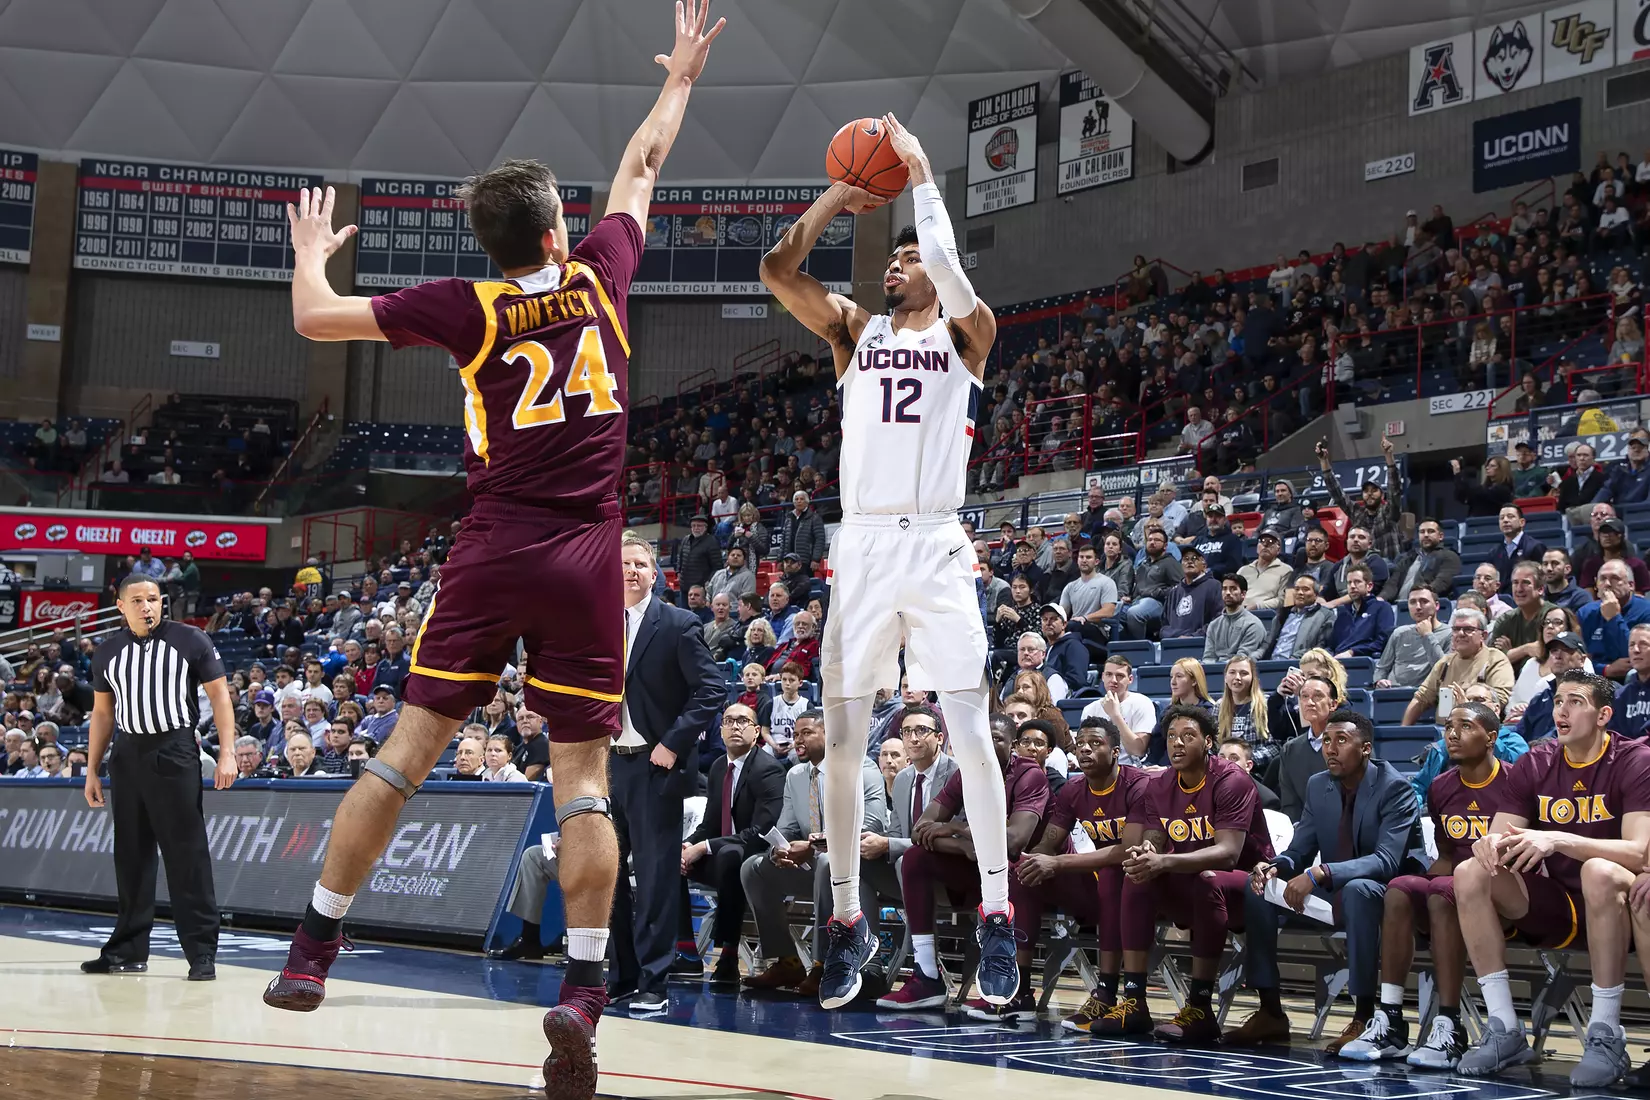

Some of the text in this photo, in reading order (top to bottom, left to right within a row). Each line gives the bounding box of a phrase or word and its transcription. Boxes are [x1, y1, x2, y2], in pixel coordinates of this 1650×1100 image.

[1552, 13, 1611, 65] UCF
[976, 85, 1036, 118] JIM CALHOUN
[972, 105, 1035, 130] CLASS OF 2005
[1483, 123, 1569, 160] UCONN
[95, 163, 309, 188] NCAA CHAMPIONSHIP
[1065, 151, 1125, 180] JIM CALHOUN
[1366, 156, 1414, 176] SEC 220
[141, 181, 263, 199] SWEET SIXTEEN
[375, 181, 426, 195] NCAA
[1060, 168, 1129, 191] FOUNDING CLASS
[702, 189, 821, 201] CHAMPIONSH
[224, 200, 248, 217] 1991
[257, 203, 283, 220] 1994
[701, 204, 784, 213] FINAL FOUR
[221, 223, 248, 240] 2003
[255, 226, 282, 242] 2004
[364, 210, 388, 226] 1964
[398, 211, 422, 227] 1990
[430, 212, 454, 228] 1995
[565, 216, 586, 233] 004
[675, 216, 683, 246] 2004
[765, 216, 773, 246] 2011
[115, 240, 142, 256] 2011
[149, 242, 177, 258] 2014
[361, 232, 484, 251] 2006 2009 2011 201
[81, 258, 295, 280] CONNECTICUT MEN'S BASKETBA
[632, 284, 717, 293] CONNECTICUT
[722, 284, 760, 293] MEN'S
[505, 289, 598, 337] VAN EYCK
[723, 306, 764, 317] SEC 10
[205, 344, 214, 356] 8
[858, 348, 949, 373] UCONN
[501, 325, 624, 430] 24
[880, 377, 923, 424] 12
[1431, 389, 1494, 411] SEC 221
[1543, 443, 1564, 459] SE
[771, 533, 783, 545] SE
[1537, 793, 1616, 825] IONA
[1440, 813, 1491, 840] ION
[2, 807, 67, 850] RUN
[376, 820, 478, 872] EAN
[369, 867, 450, 897] Gasoline
